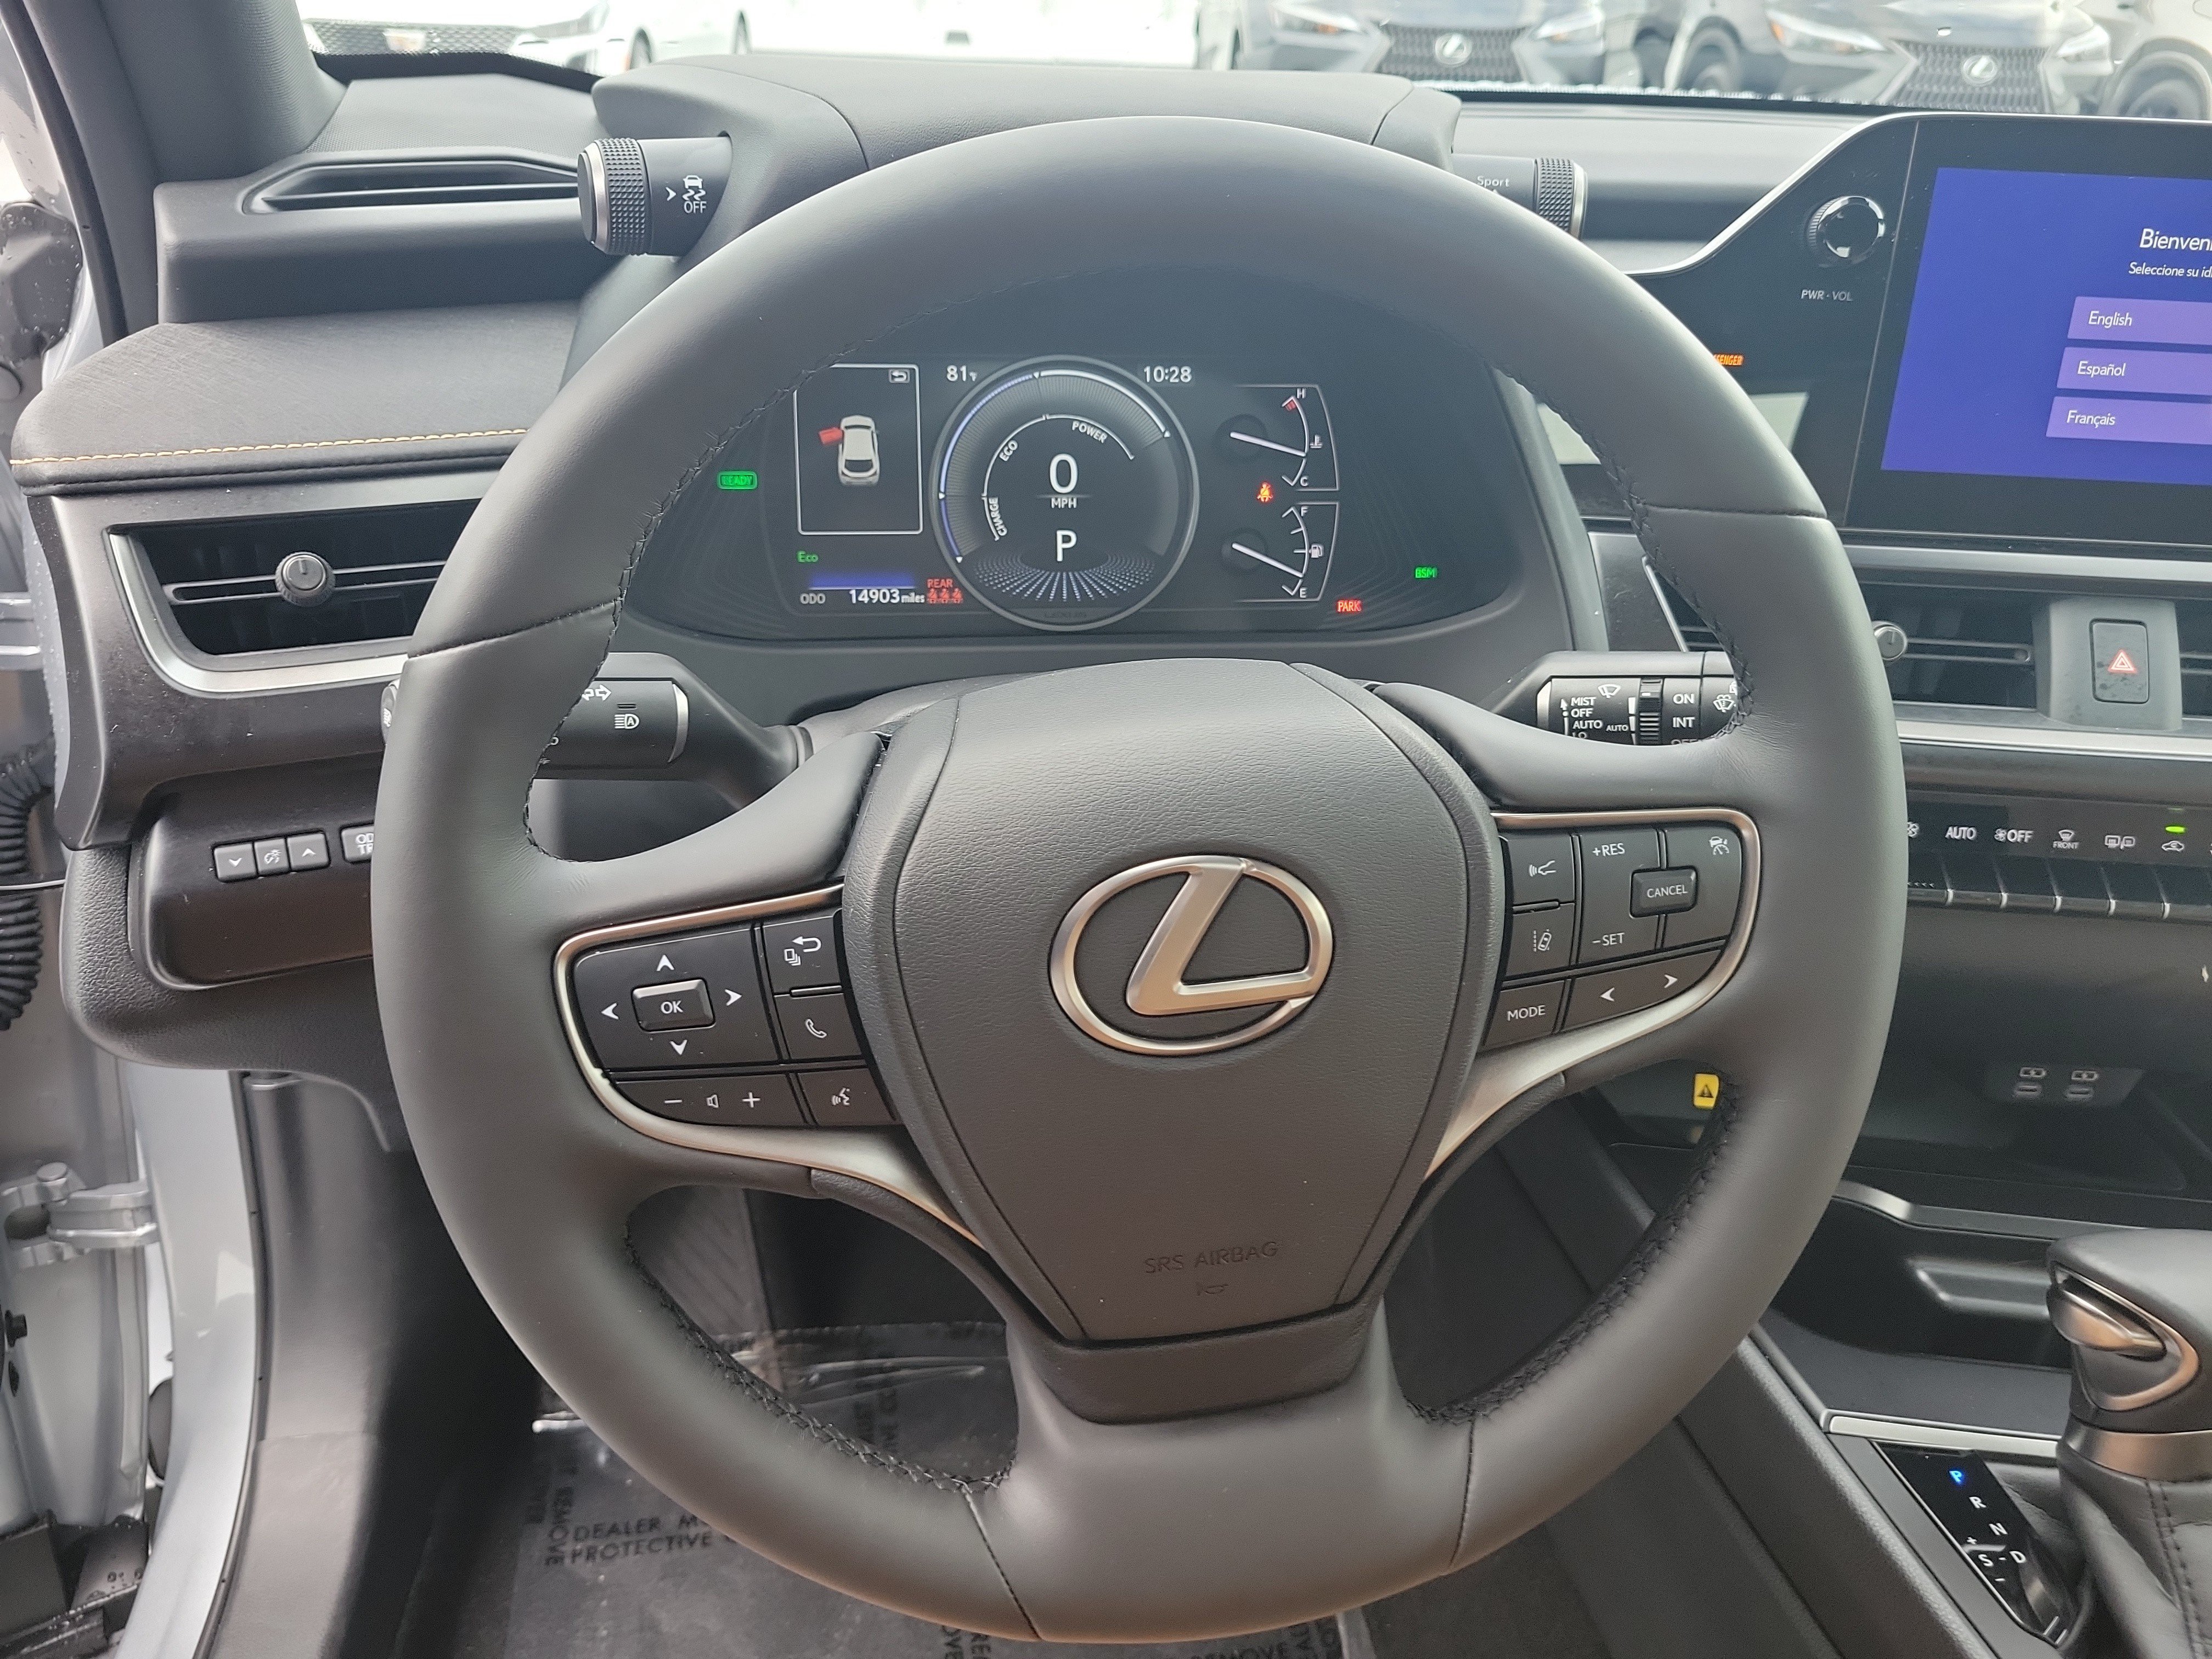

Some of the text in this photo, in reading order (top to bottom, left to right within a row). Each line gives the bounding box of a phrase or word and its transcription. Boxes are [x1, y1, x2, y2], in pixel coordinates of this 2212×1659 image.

[1477, 176, 1509, 188] Sport
[684, 201, 707, 213] OFF
[2129, 262, 2184, 277] Seleccione
[2186, 268, 2199, 277] su
[1801, 289, 1853, 301] PWR VOL
[2089, 311, 2132, 329] English
[1143, 365, 1192, 382] 10:28
[2077, 360, 2126, 377] Español
[1297, 388, 1306, 398] H
[2066, 409, 2116, 428] Français
[1071, 420, 1108, 443] POWER
[999, 440, 1018, 461] ECO
[1049, 453, 1079, 493] 0
[721, 474, 753, 486] READY
[1300, 476, 1308, 487] C
[1051, 498, 1077, 509] MPH
[989, 497, 1007, 537] CHARGE
[1301, 506, 1308, 517] F
[1056, 530, 1077, 562] P
[797, 551, 818, 563] Eco
[1415, 567, 1437, 579] BSM
[927, 578, 953, 589] REAR
[800, 589, 925, 604] ODO 14903 miles
[1300, 588, 1307, 599] E
[1337, 601, 1362, 612] PARK
[1571, 696, 1595, 707] MIST
[1673, 693, 1695, 704] ON
[1571, 708, 1593, 718] OFF
[1573, 720, 1603, 729] AUTO
[1673, 717, 1695, 728] INT
[356, 833, 374, 844] OD
[1945, 826, 1977, 840] AUTO
[2007, 829, 2034, 843] OFF
[2053, 840, 2079, 849] FRONT
[1647, 884, 1688, 899] CANCEL
[661, 1001, 684, 1014] OK
[1507, 1005, 1546, 1021] MODE
[1145, 1241, 1279, 1273] SRS AIRBAG
[1949, 1470, 1962, 1483] P
[1969, 1496, 1987, 1509] R
[573, 1516, 662, 1542] DEALER
[1989, 1522, 2008, 1536] N
[571, 1531, 713, 1564] PROTECTIVE
[1978, 1554, 1994, 1567] S
[2010, 1550, 2027, 1564] D
